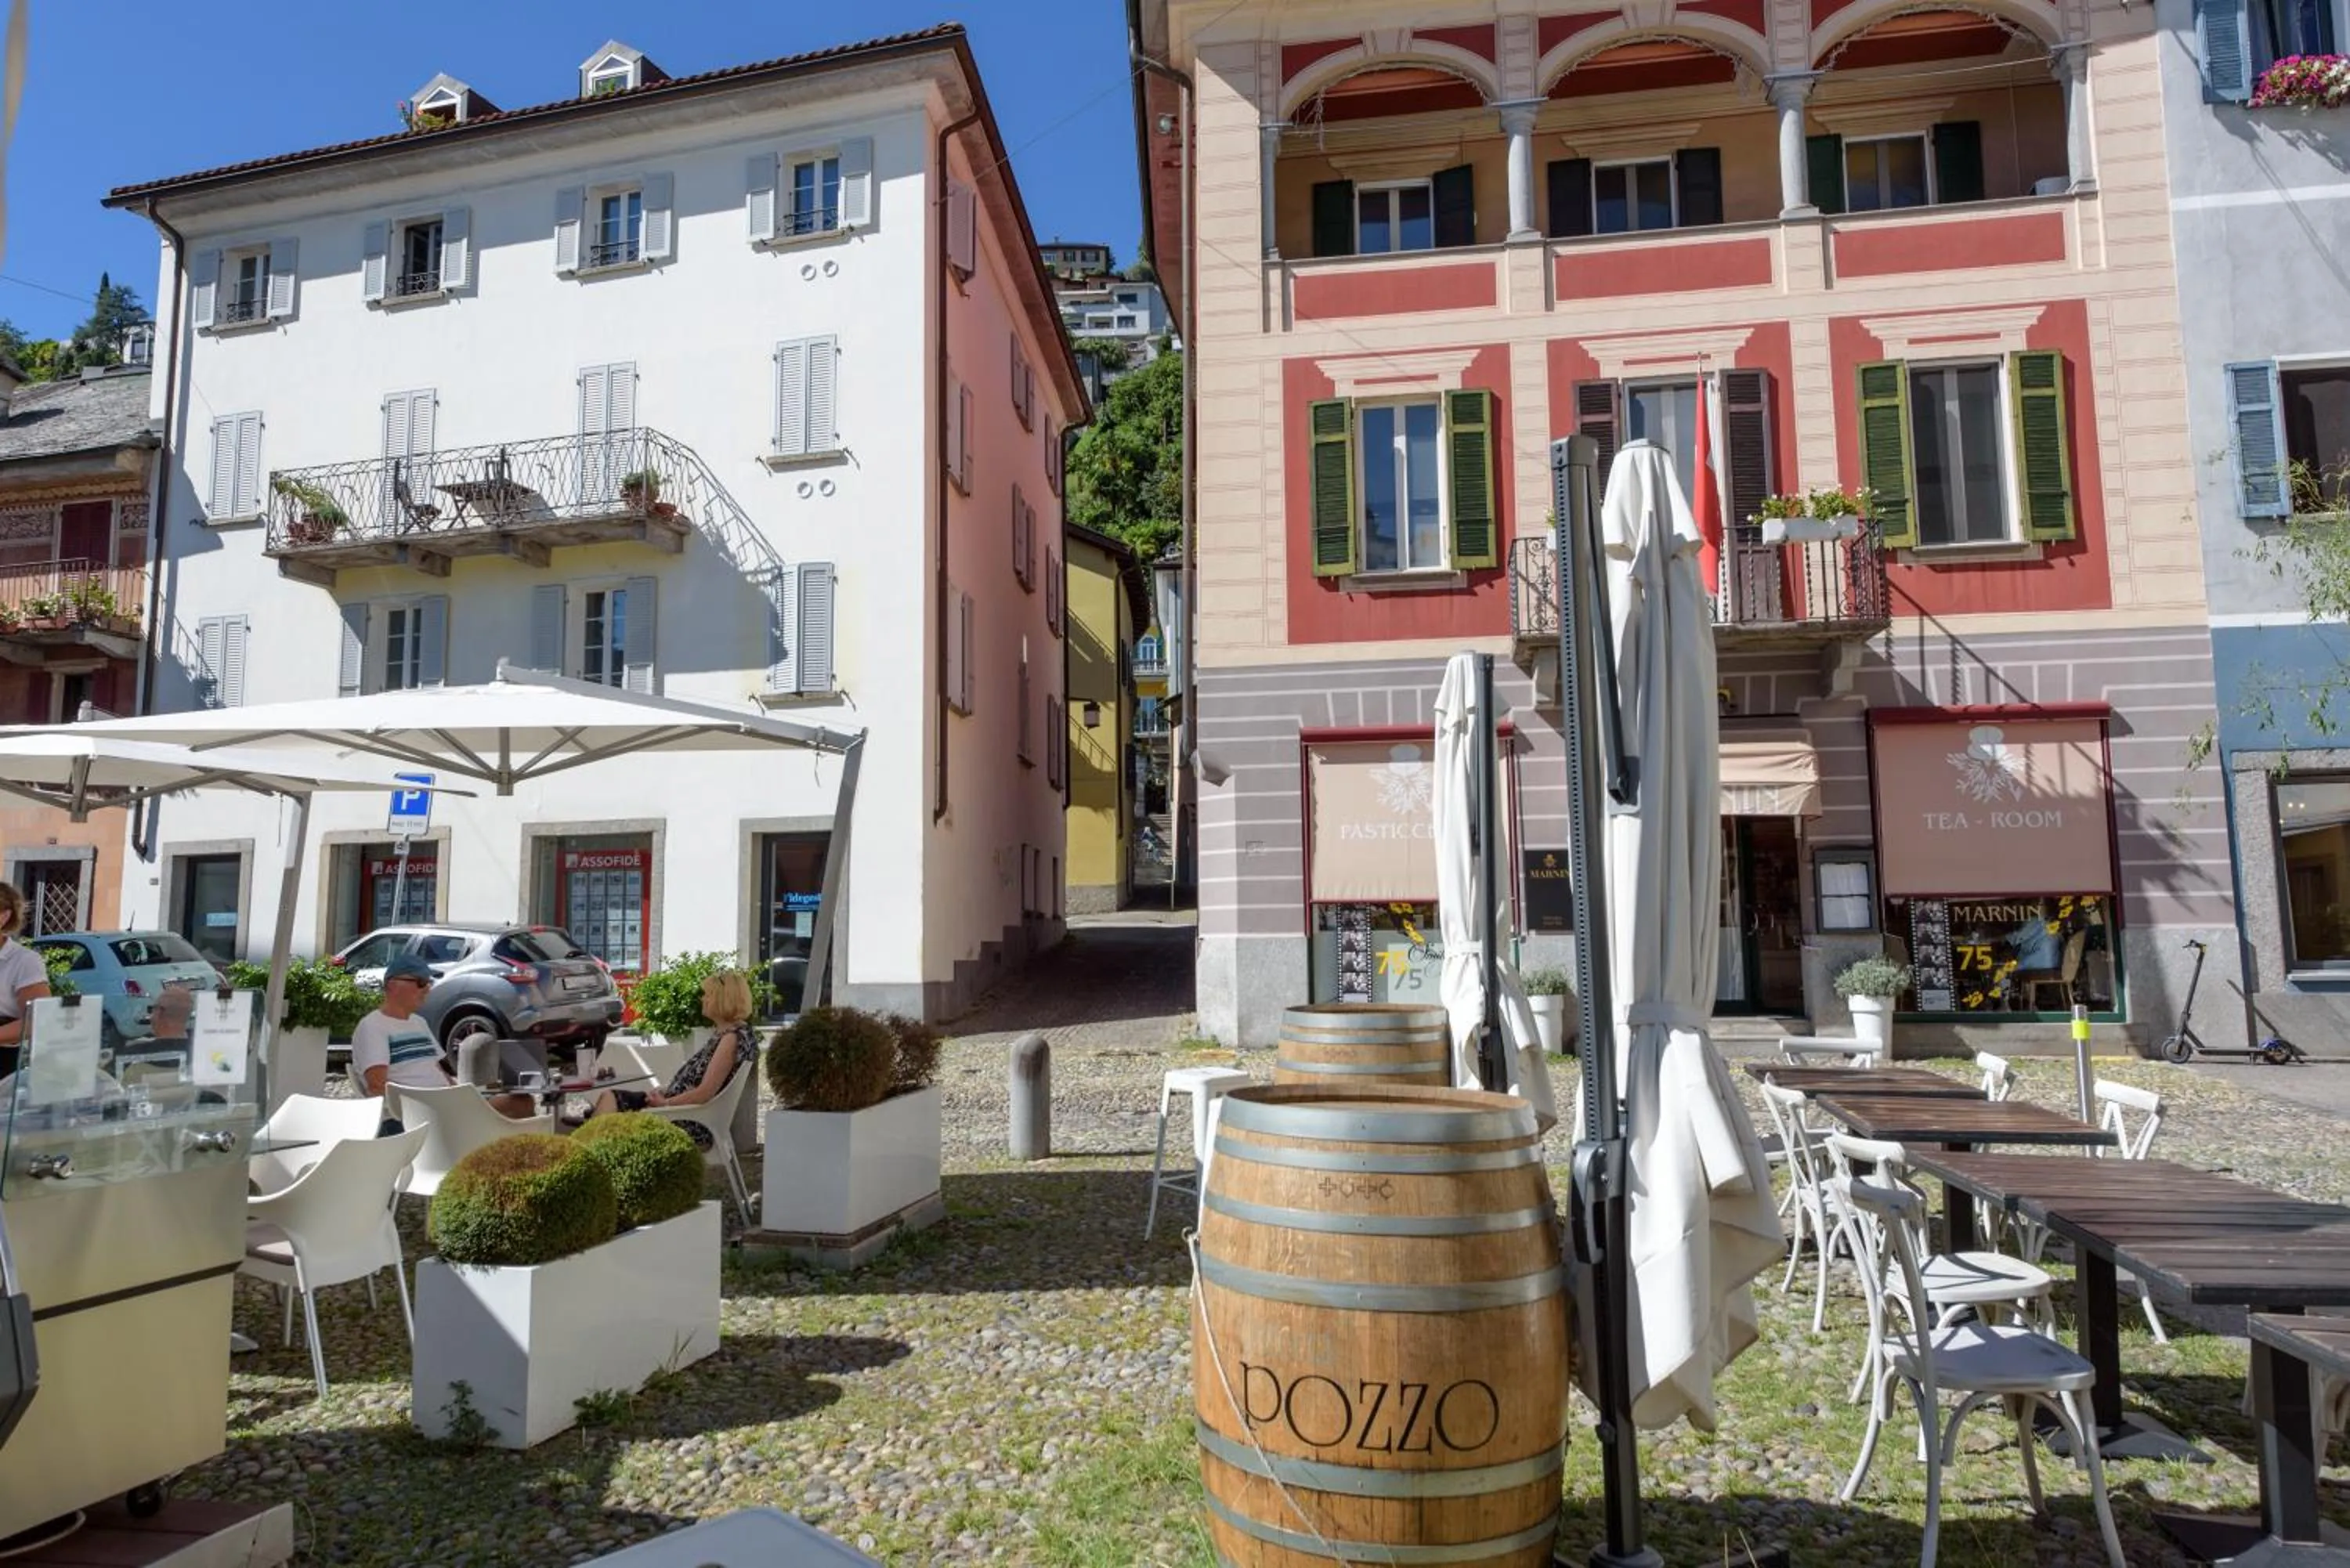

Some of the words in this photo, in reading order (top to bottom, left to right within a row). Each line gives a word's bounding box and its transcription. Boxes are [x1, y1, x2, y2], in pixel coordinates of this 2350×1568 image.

[1923, 811, 1969, 830] TEA
[1990, 810, 2063, 829] ROOM
[1340, 821, 1434, 840] PASTICC
[1954, 904, 2042, 923] MARNIN
[1957, 945, 1994, 971] 75
[1239, 1360, 1500, 1455] POZZO
